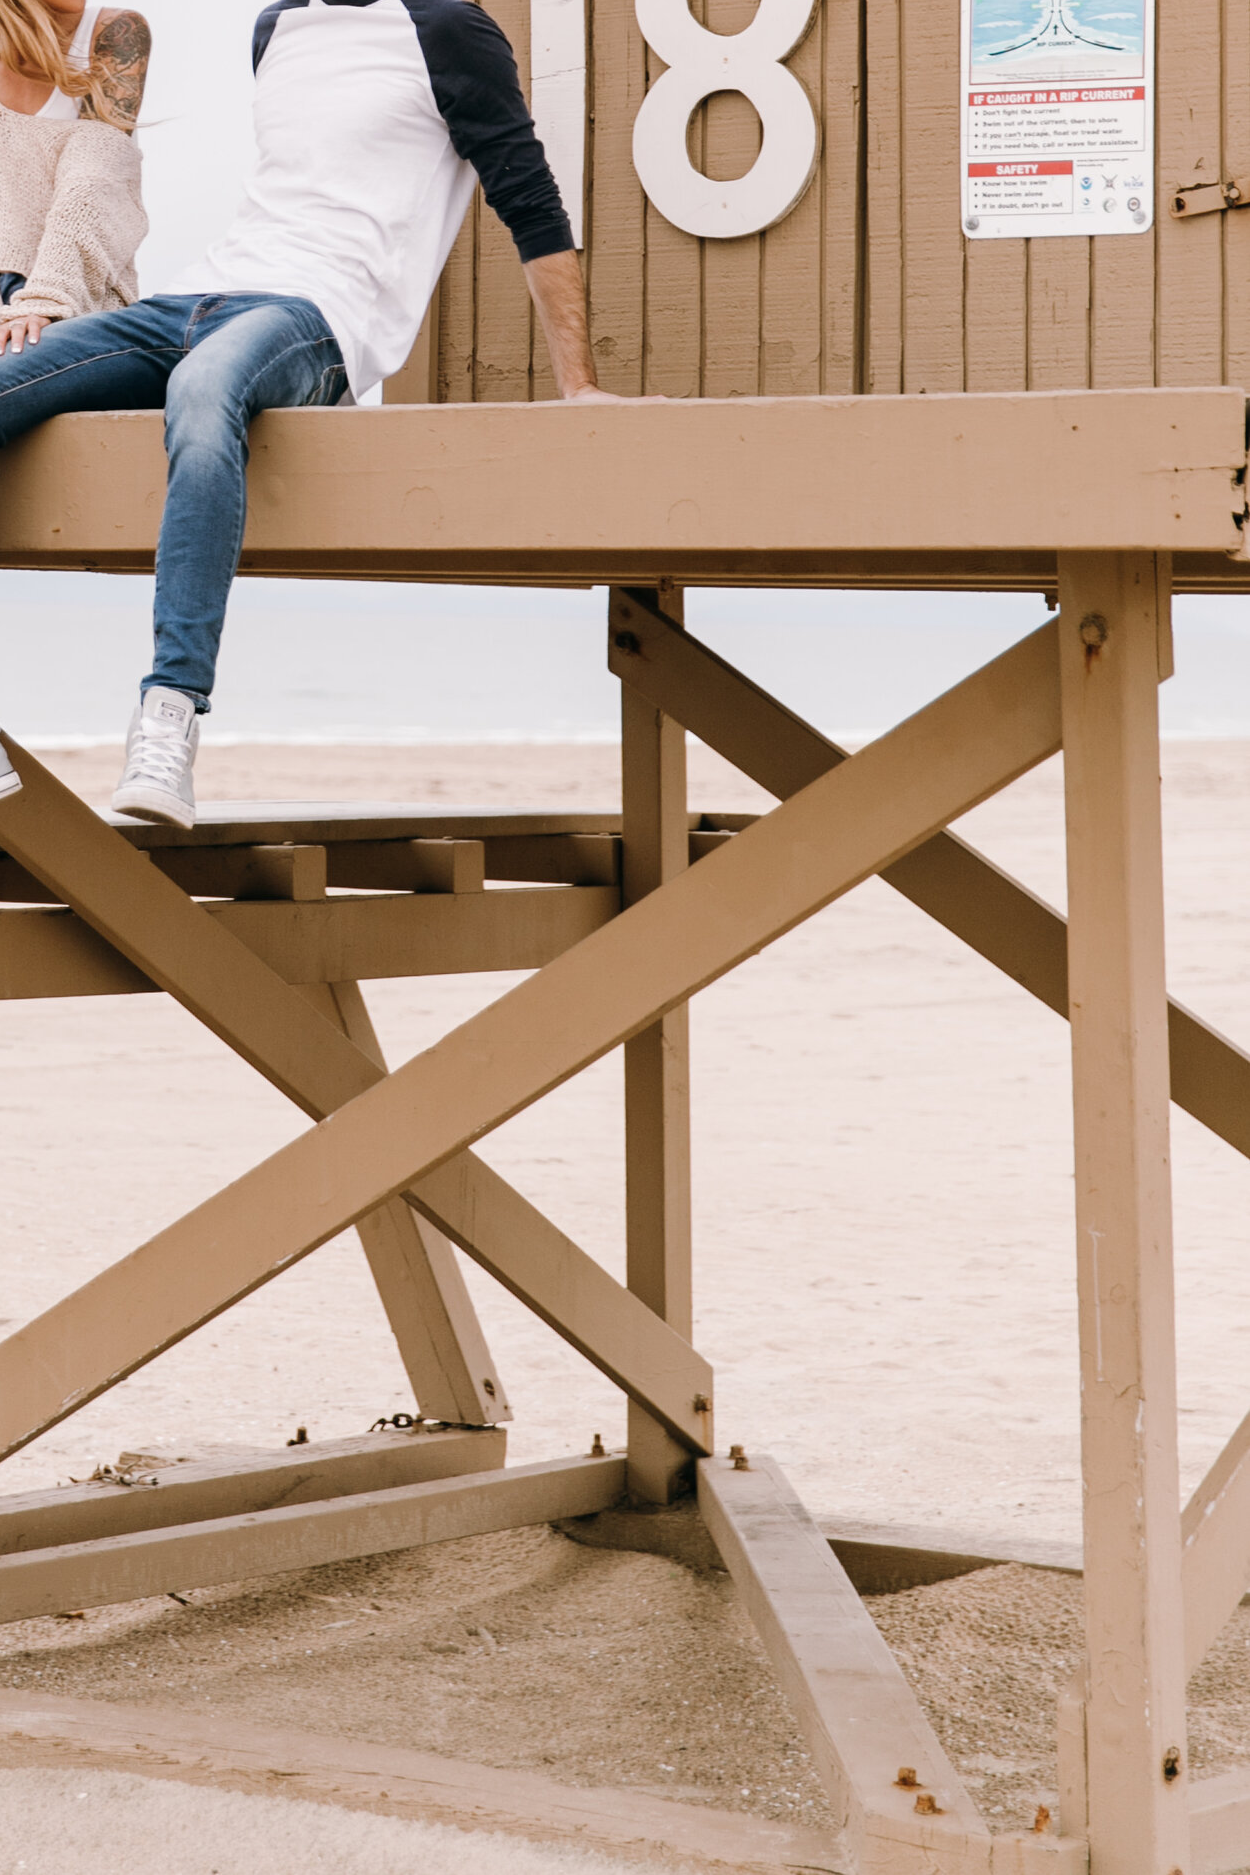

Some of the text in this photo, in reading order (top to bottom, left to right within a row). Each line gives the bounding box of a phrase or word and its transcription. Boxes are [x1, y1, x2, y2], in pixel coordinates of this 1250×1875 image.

[973, 89, 1136, 105] IF CAUGHT IN A RIP CURRENT
[1002, 109, 1019, 117] fight
[1023, 131, 1051, 139] escape,
[1023, 142, 1040, 150] help,
[995, 164, 1039, 175] SAFETY
